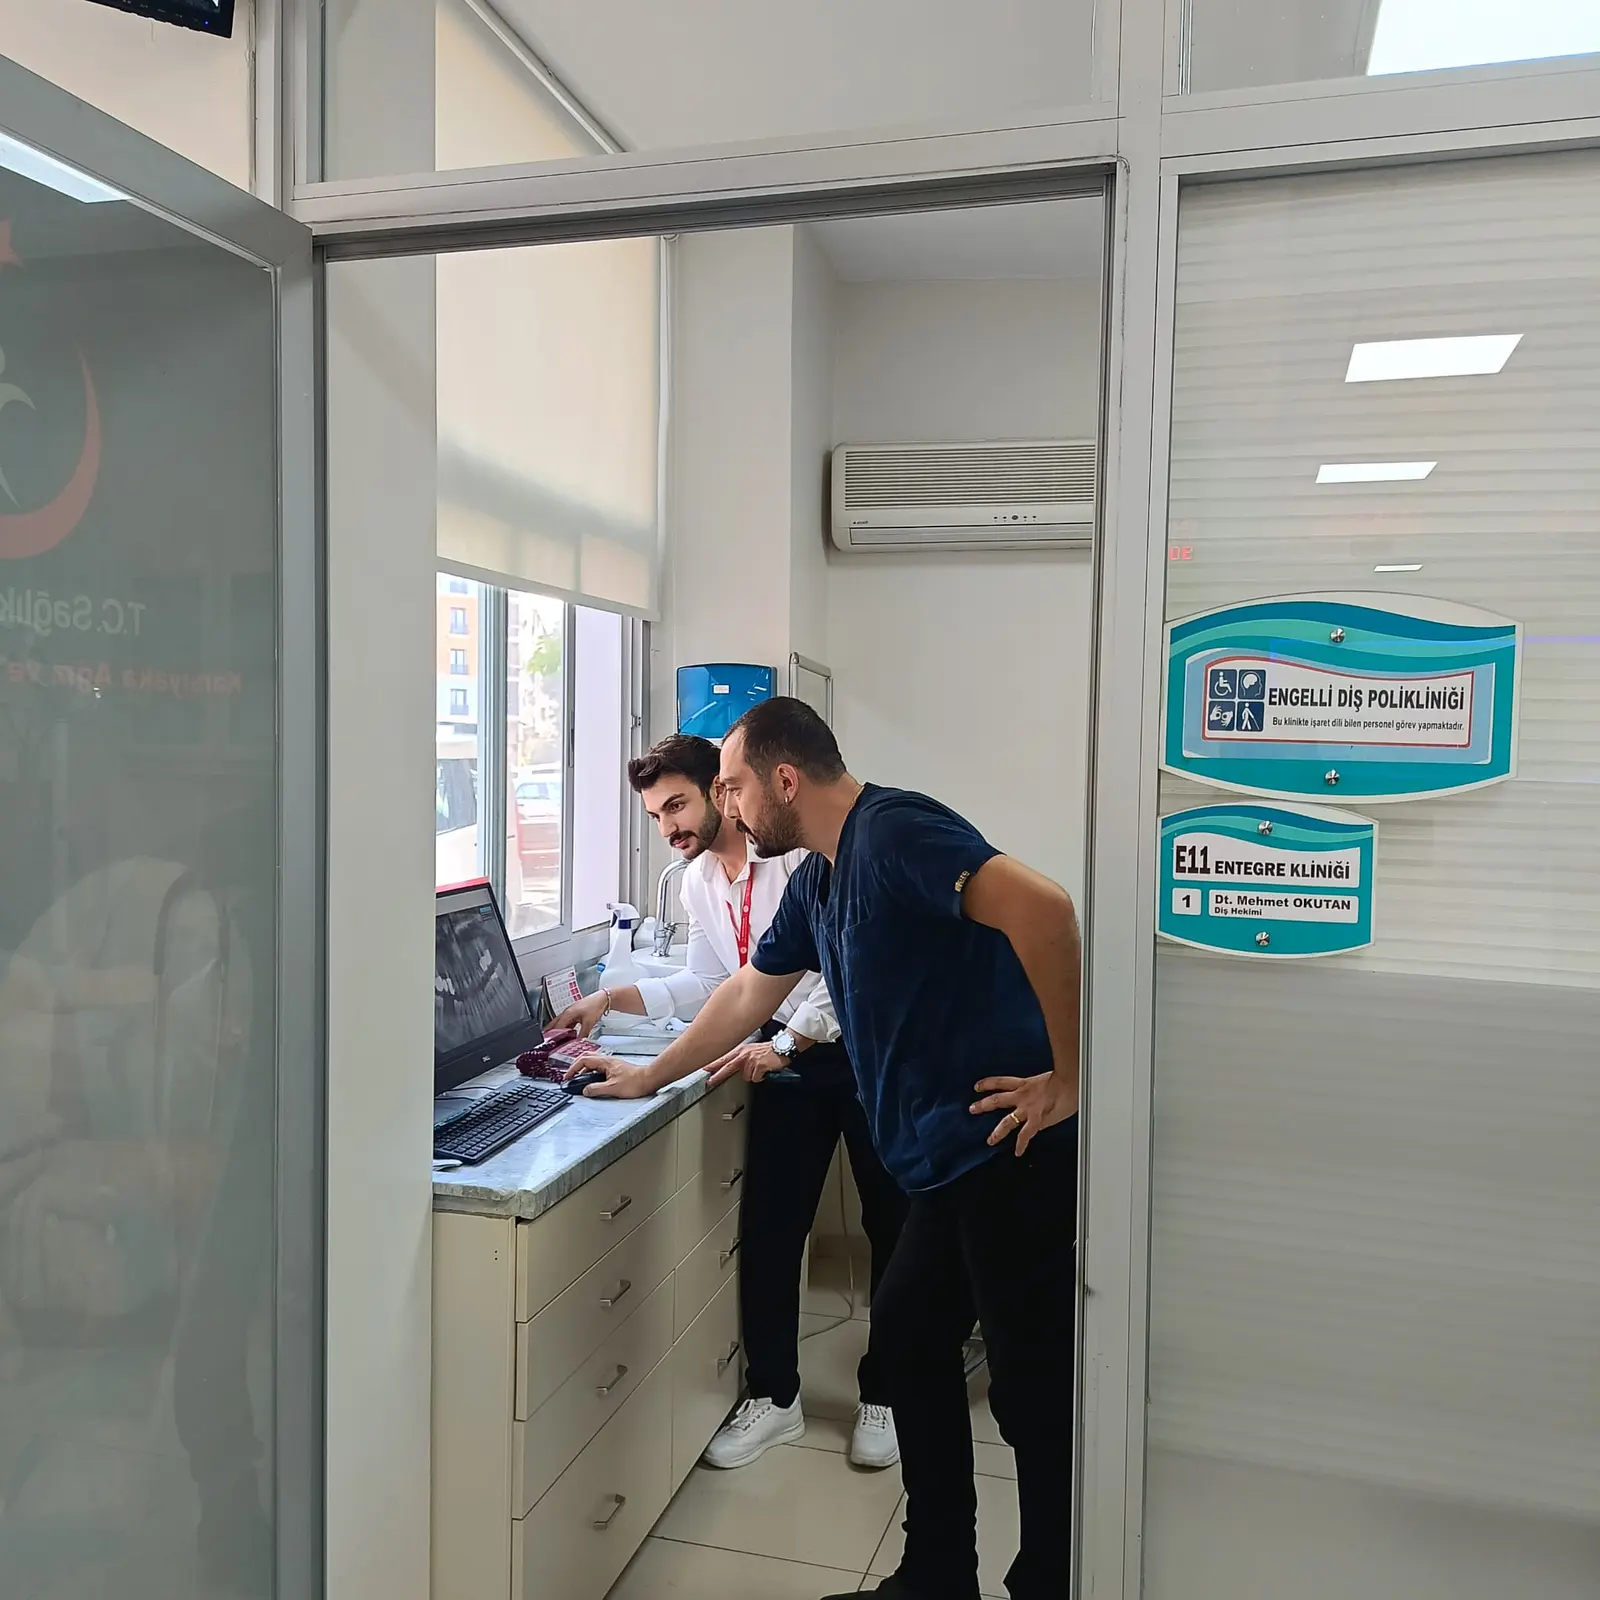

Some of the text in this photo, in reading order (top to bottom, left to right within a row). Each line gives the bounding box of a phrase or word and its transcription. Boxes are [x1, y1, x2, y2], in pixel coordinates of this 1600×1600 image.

[1268, 684, 1464, 713] ENGELLİ DİŞ POLİKLİNİĞİ
[1272, 717, 1465, 732] Bu klinikte işaret dili bilen personel görev yapmaktadır.
[1175, 845, 1350, 880] E11 ENTEGRE KLİNİĞİ
[1181, 894, 1191, 908] 1
[1215, 894, 1351, 910] Dt. Mehmet OKUTAN
[1214, 906, 1263, 916] Diş Hekimi
